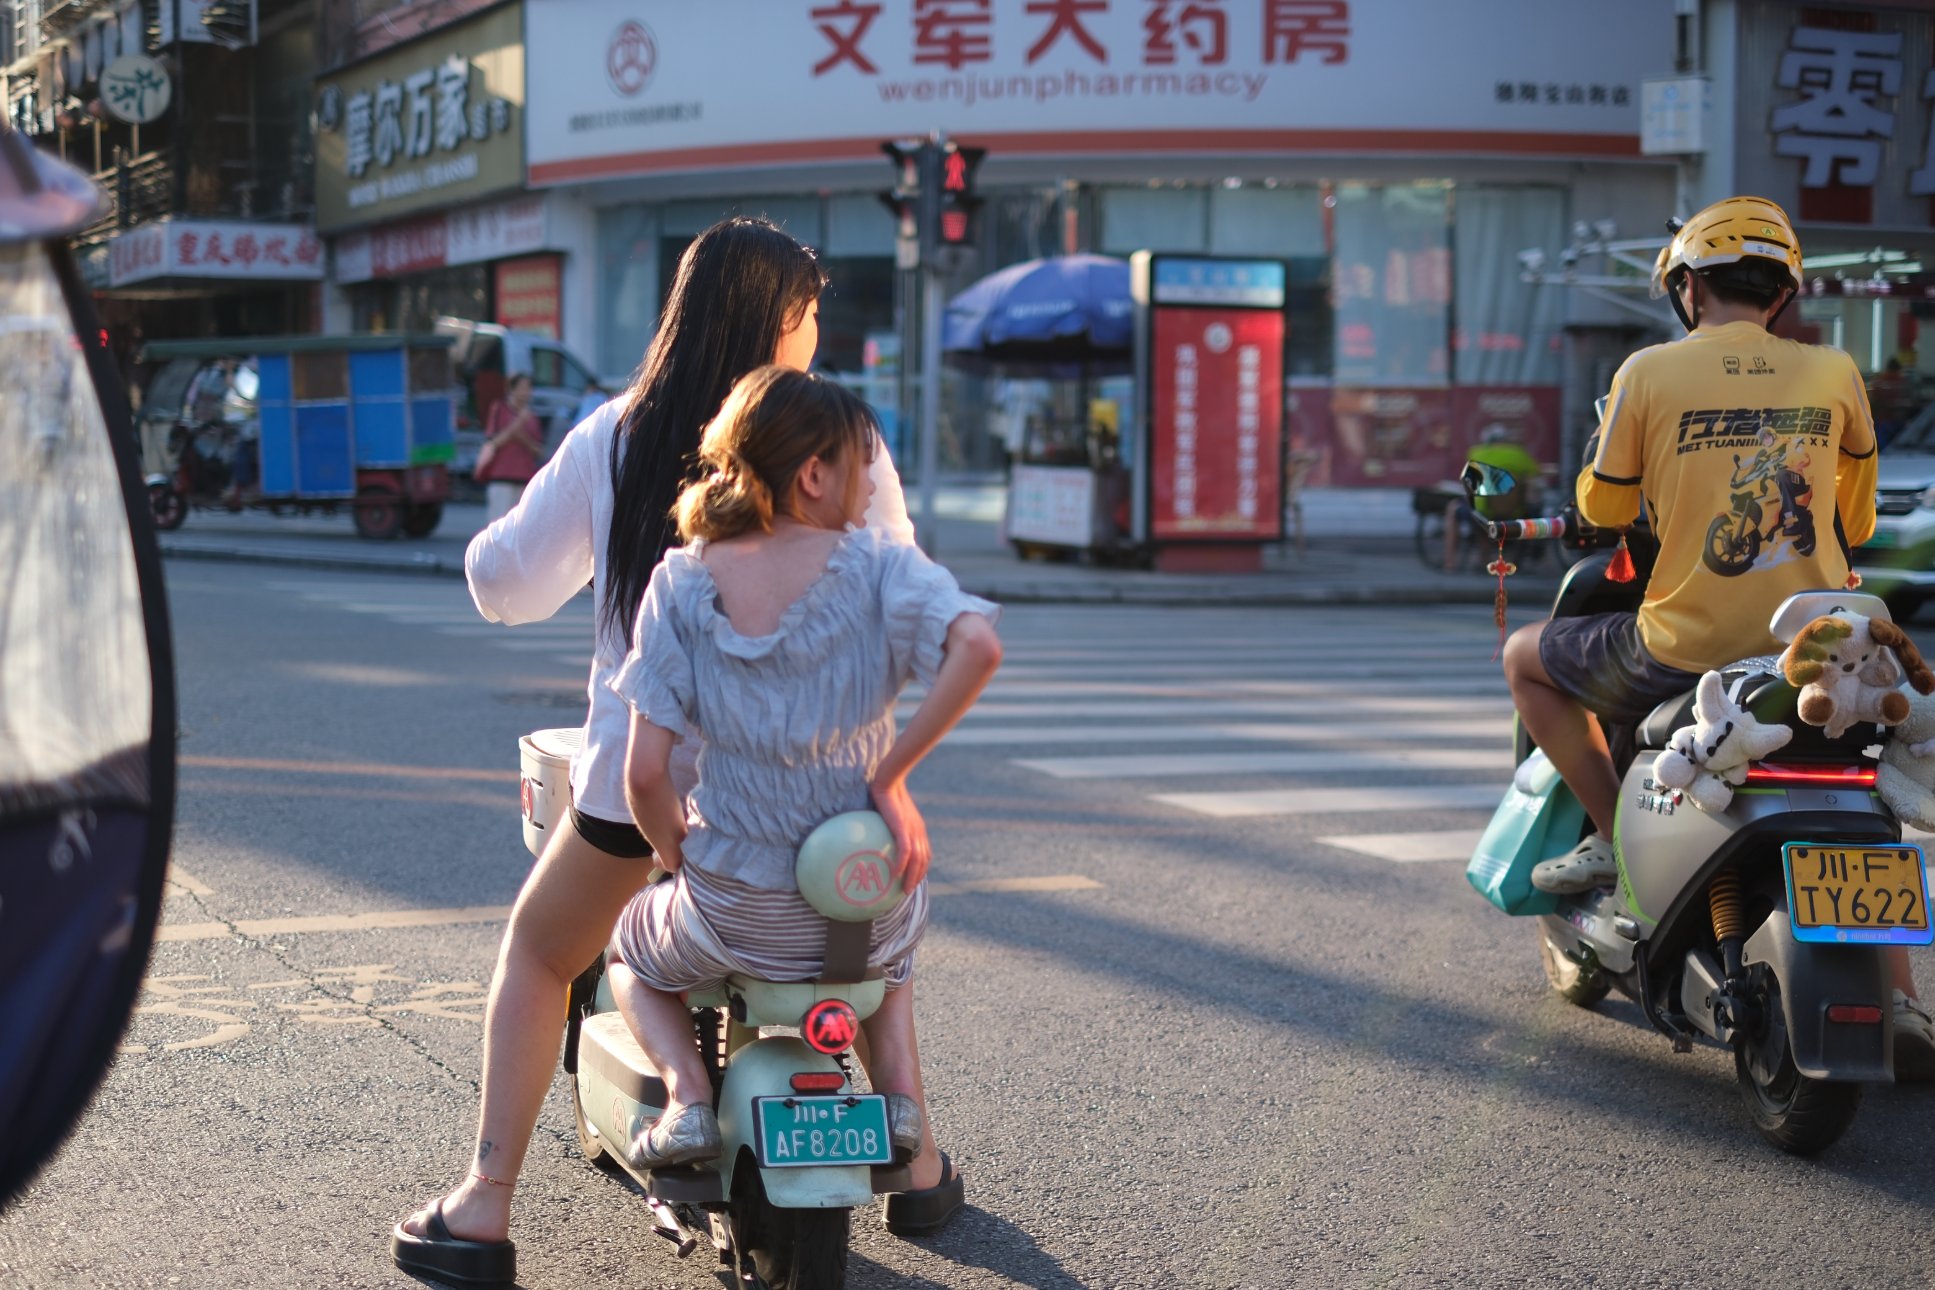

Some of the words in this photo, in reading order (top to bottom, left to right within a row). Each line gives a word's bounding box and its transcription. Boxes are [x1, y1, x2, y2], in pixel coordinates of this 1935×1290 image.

[808, 0, 1353, 77] 文军大药房
[876, 70, 1268, 104] wenjunpharmacy
[1677, 442, 1701, 456] MEI
[1800, 886, 1919, 925] TY622
[775, 1128, 878, 1158] AF8208
